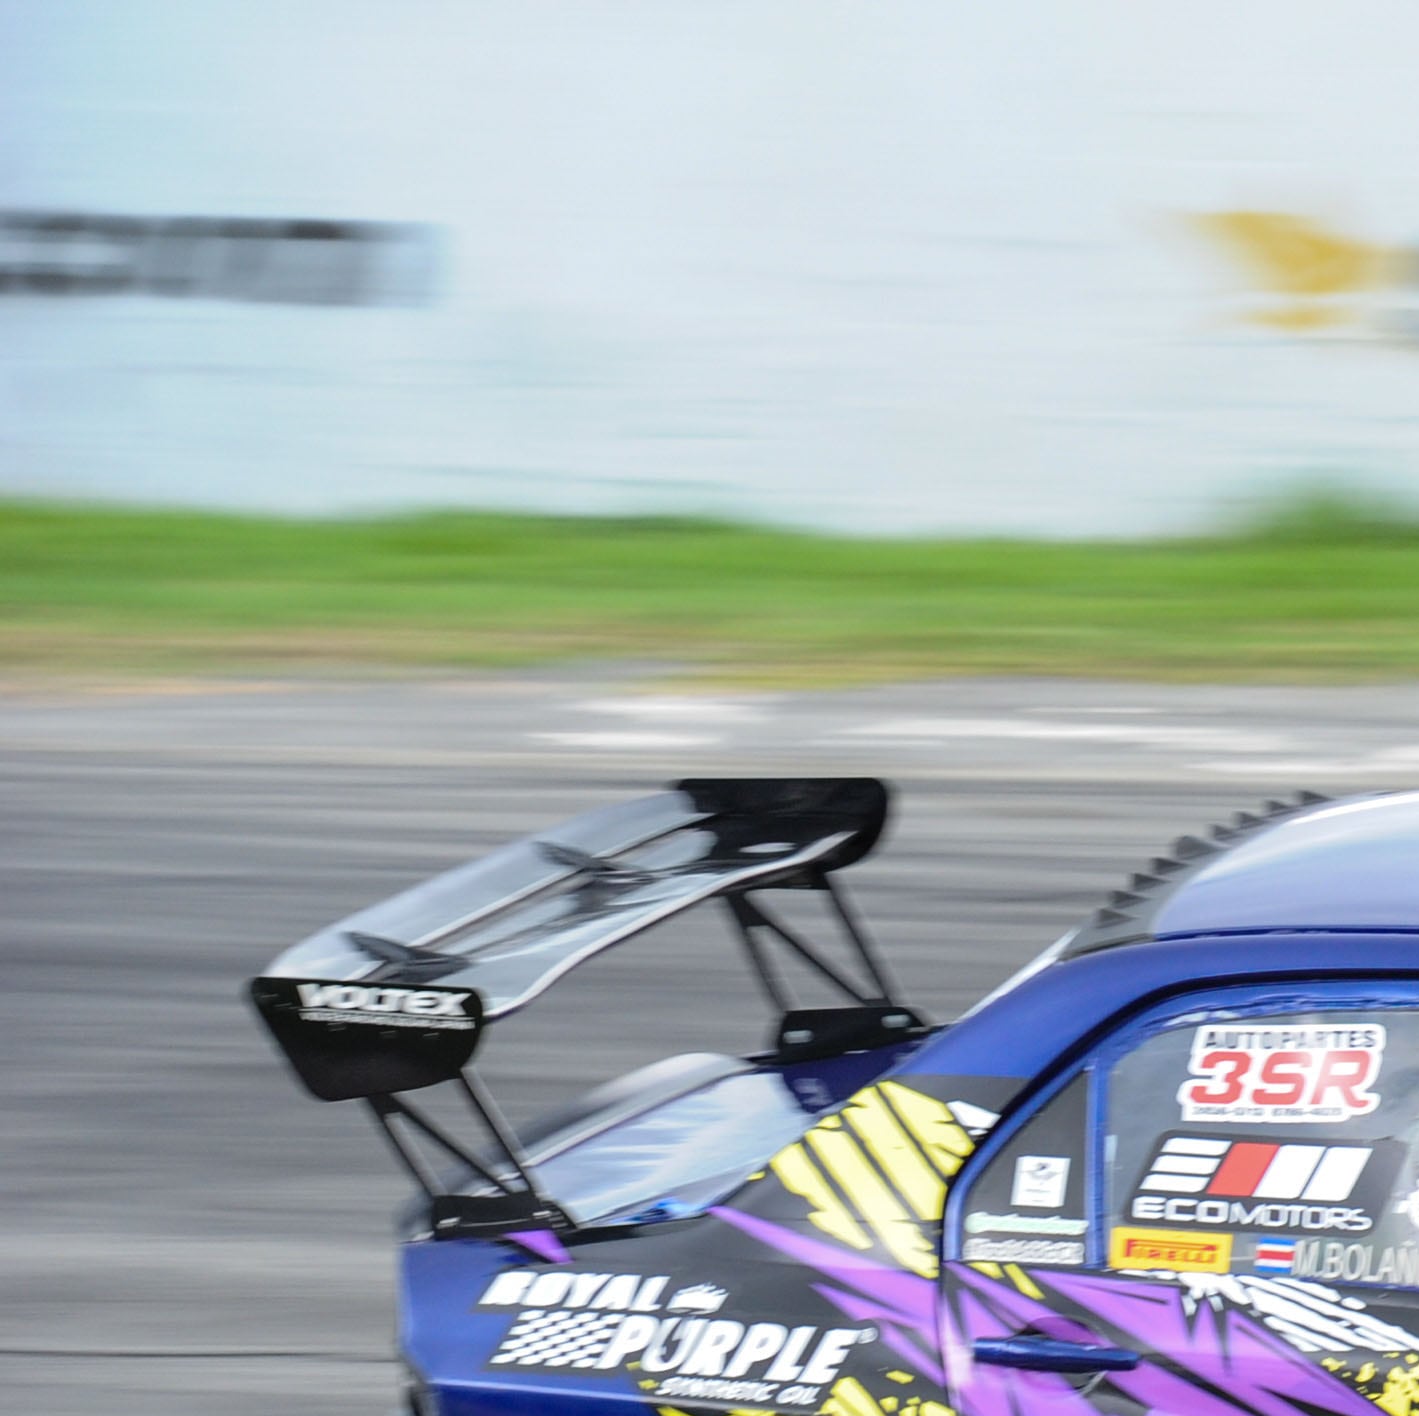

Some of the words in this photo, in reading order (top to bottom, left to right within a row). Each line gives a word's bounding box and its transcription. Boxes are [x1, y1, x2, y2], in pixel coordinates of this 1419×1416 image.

[296, 983, 472, 1017] VOLTEX
[1205, 1029, 1378, 1050] AUTOPARTES
[1189, 1050, 1372, 1108] 3SR
[1131, 1196, 1374, 1232] ECOMOTORS
[1123, 1238, 1217, 1264] PIRELLI
[478, 1271, 671, 1312] ROYAL
[593, 1314, 862, 1384] PURPLE
[775, 1384, 822, 1406] OIL
